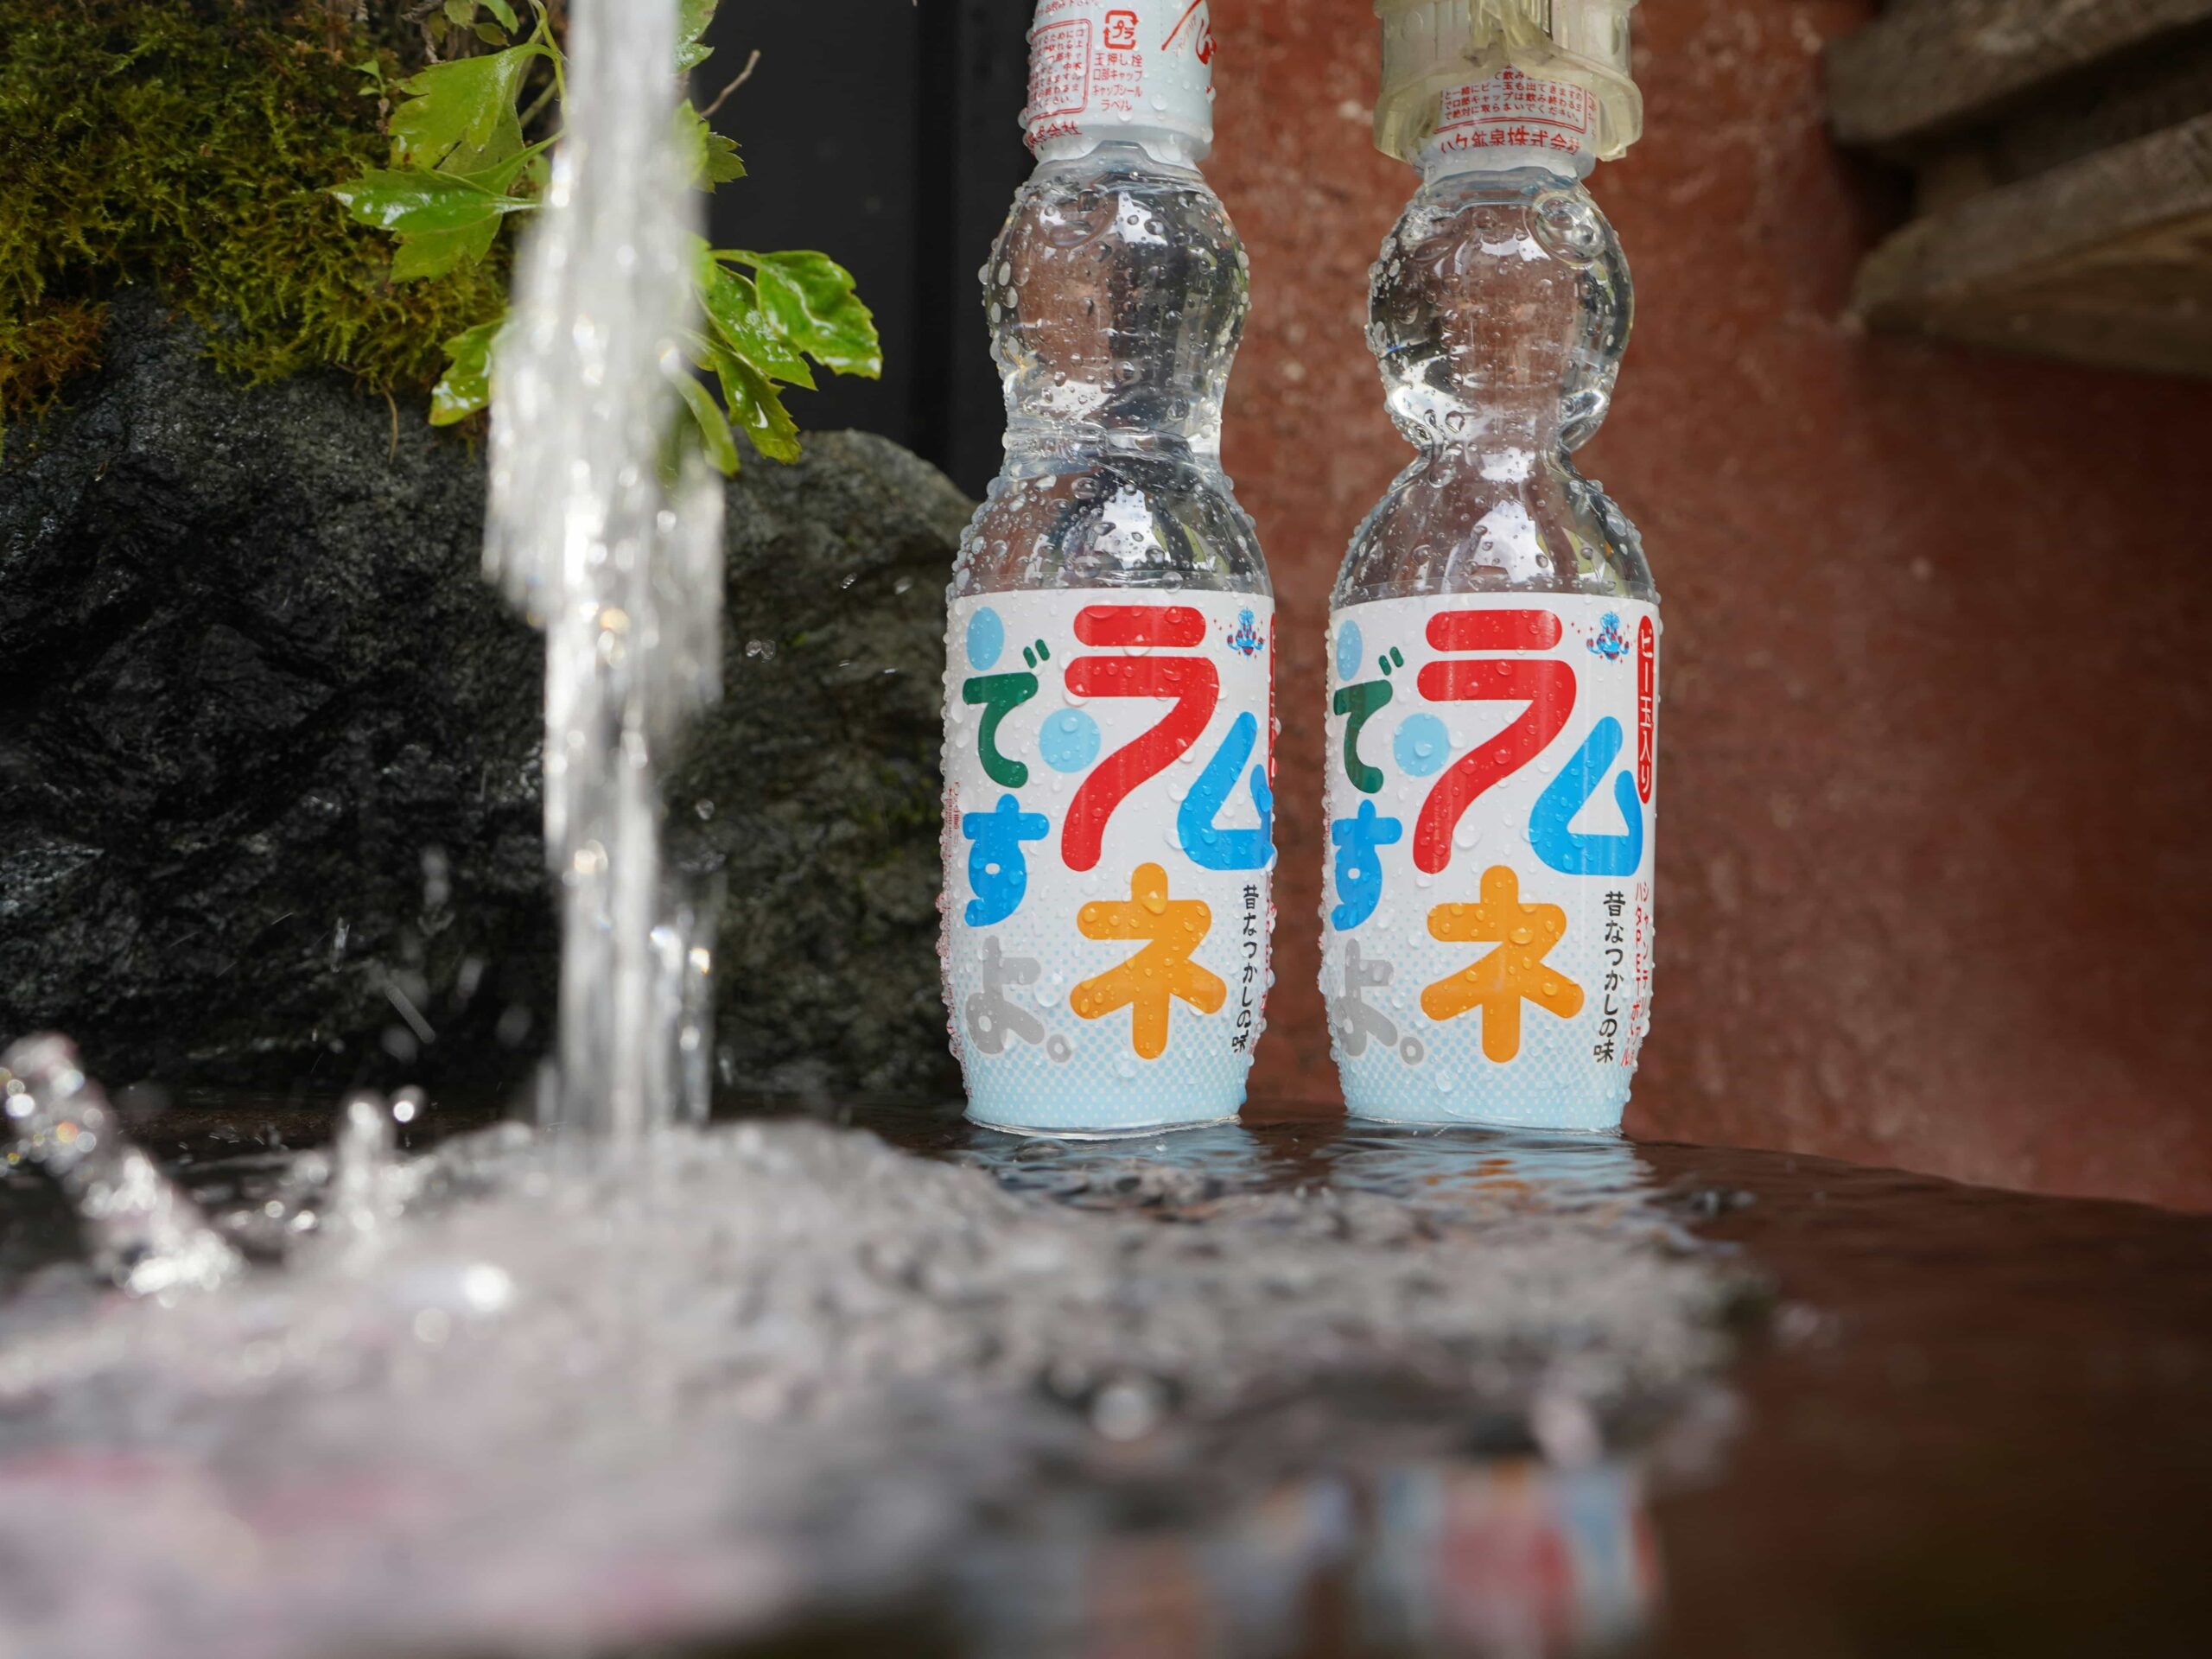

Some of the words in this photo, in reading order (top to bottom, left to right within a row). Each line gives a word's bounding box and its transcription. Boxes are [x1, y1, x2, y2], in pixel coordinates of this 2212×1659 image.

[1101, 99, 1132, 111] ラベル
[1113, 20, 1134, 39] プラ
[1640, 628, 1653, 793] ビー玉入り
[1231, 884, 1259, 1053] 昔なつかしの味
[1593, 891, 1626, 1064] 昔なつかしの味
